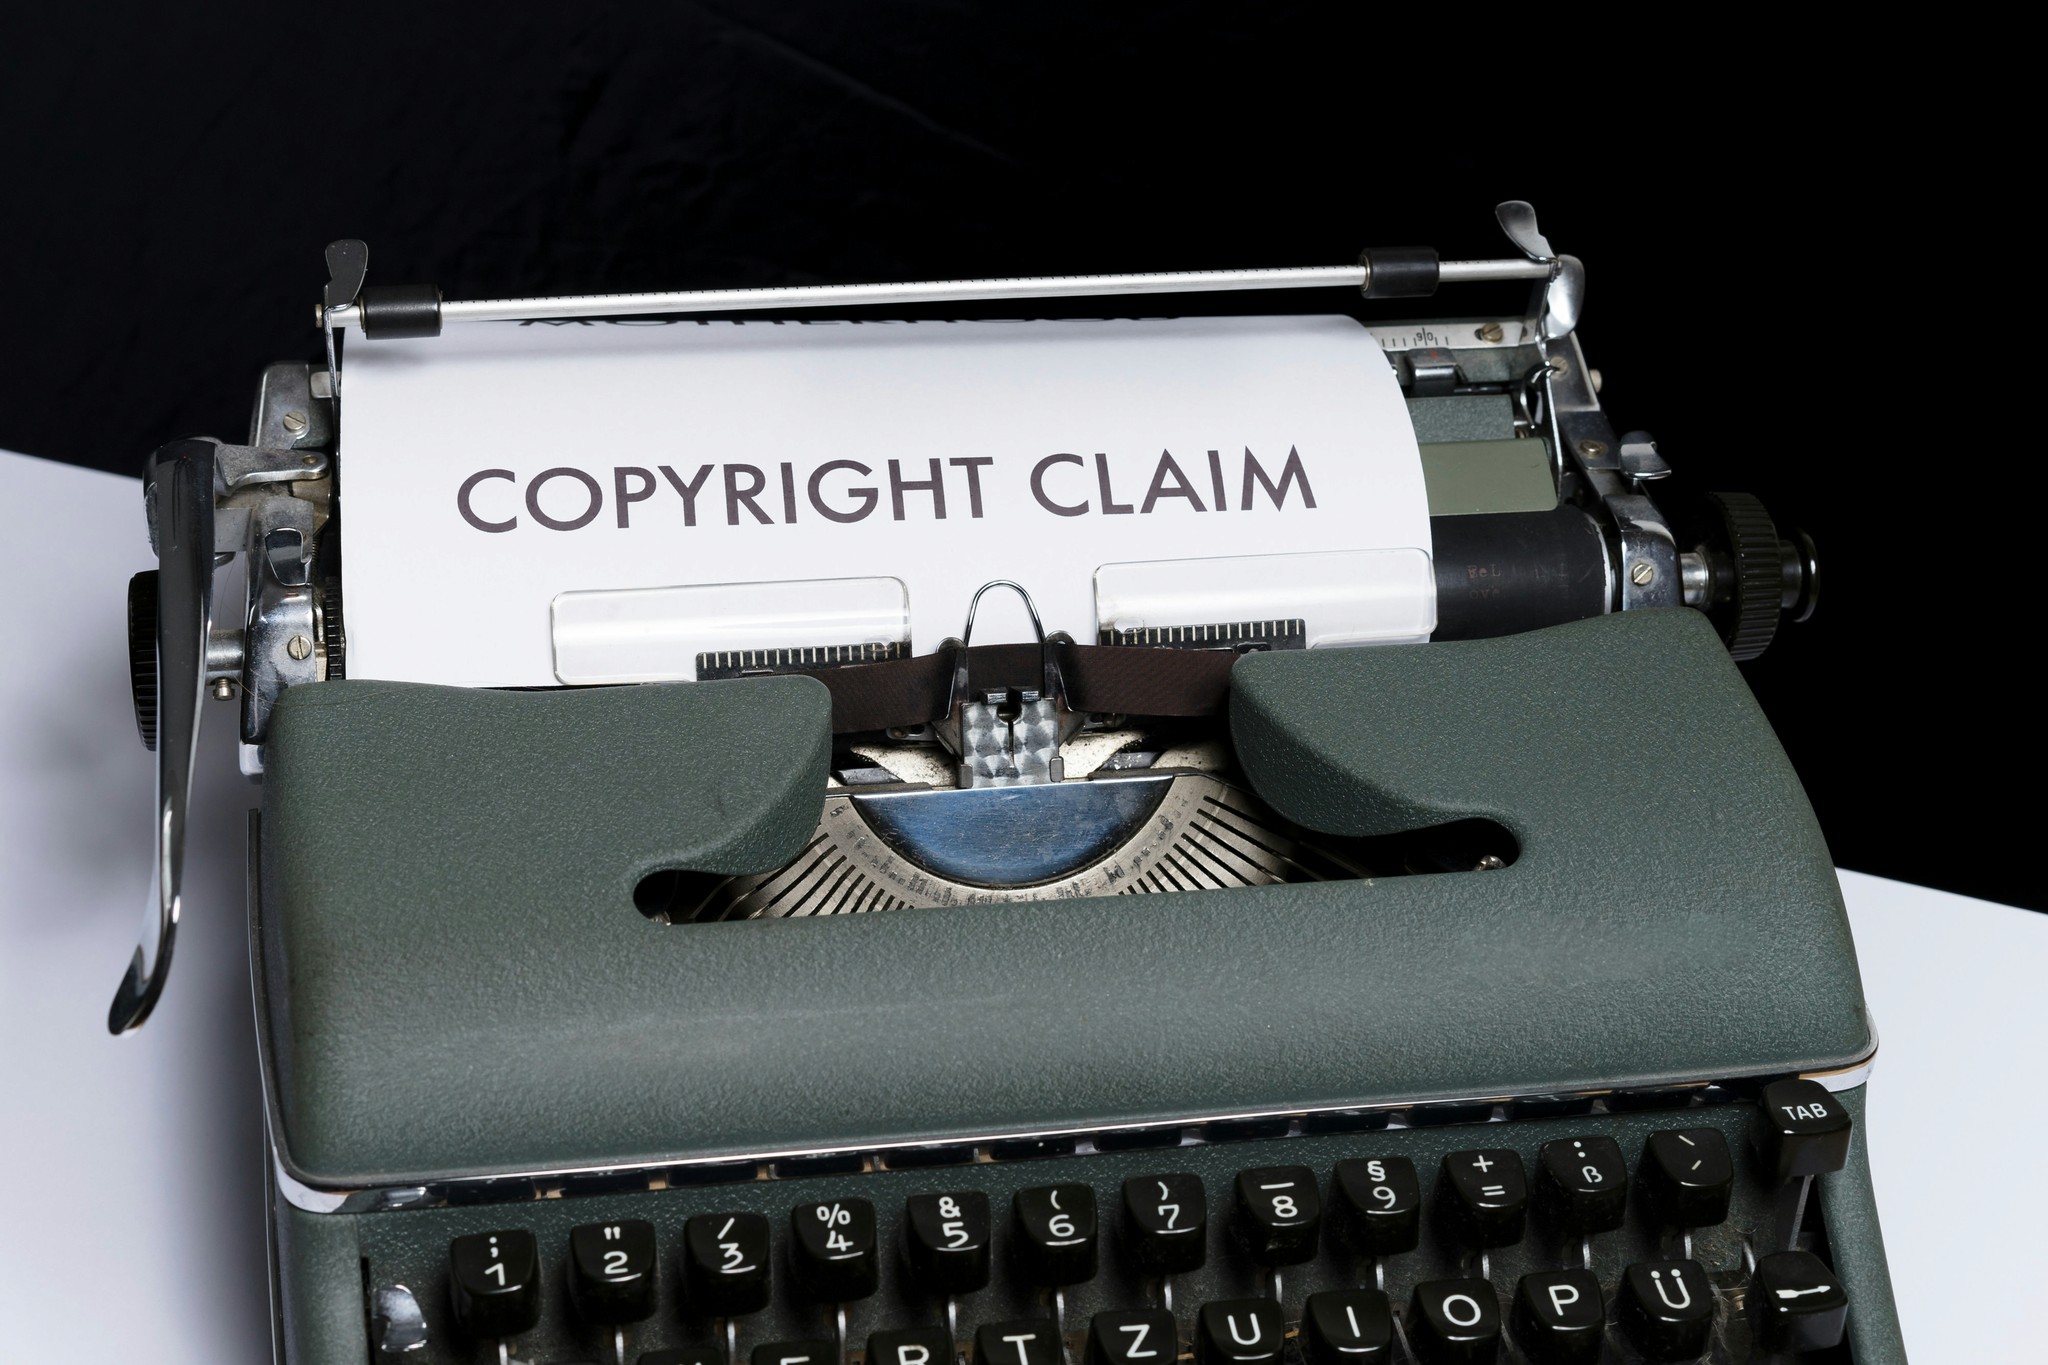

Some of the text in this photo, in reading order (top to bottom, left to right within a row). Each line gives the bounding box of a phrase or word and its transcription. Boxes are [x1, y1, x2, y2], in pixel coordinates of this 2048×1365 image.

[458, 445, 1316, 533] COPYRIGHT CLAIM
[1782, 1103, 1827, 1120] TAB
[939, 1197, 961, 1218] &
[1272, 1196, 1297, 1217] 8
[1373, 1187, 1395, 1208] 9
[817, 1204, 850, 1227] %
[1049, 1215, 1074, 1236] 6
[1158, 1204, 1179, 1229] 7
[826, 1231, 853, 1251] 4
[943, 1222, 968, 1248] 5
[604, 1251, 628, 1274] 2
[720, 1243, 744, 1270] 3
[485, 1263, 505, 1285] 1
[1549, 1285, 1579, 1315] P
[1651, 1269, 1690, 1308] Ü
[1347, 1306, 1360, 1337] I
[1443, 1295, 1481, 1326] O
[1120, 1324, 1157, 1357] Z
[1228, 1313, 1261, 1345] U
[898, 1346, 929, 1365] R
[1003, 1334, 1035, 1365] T
